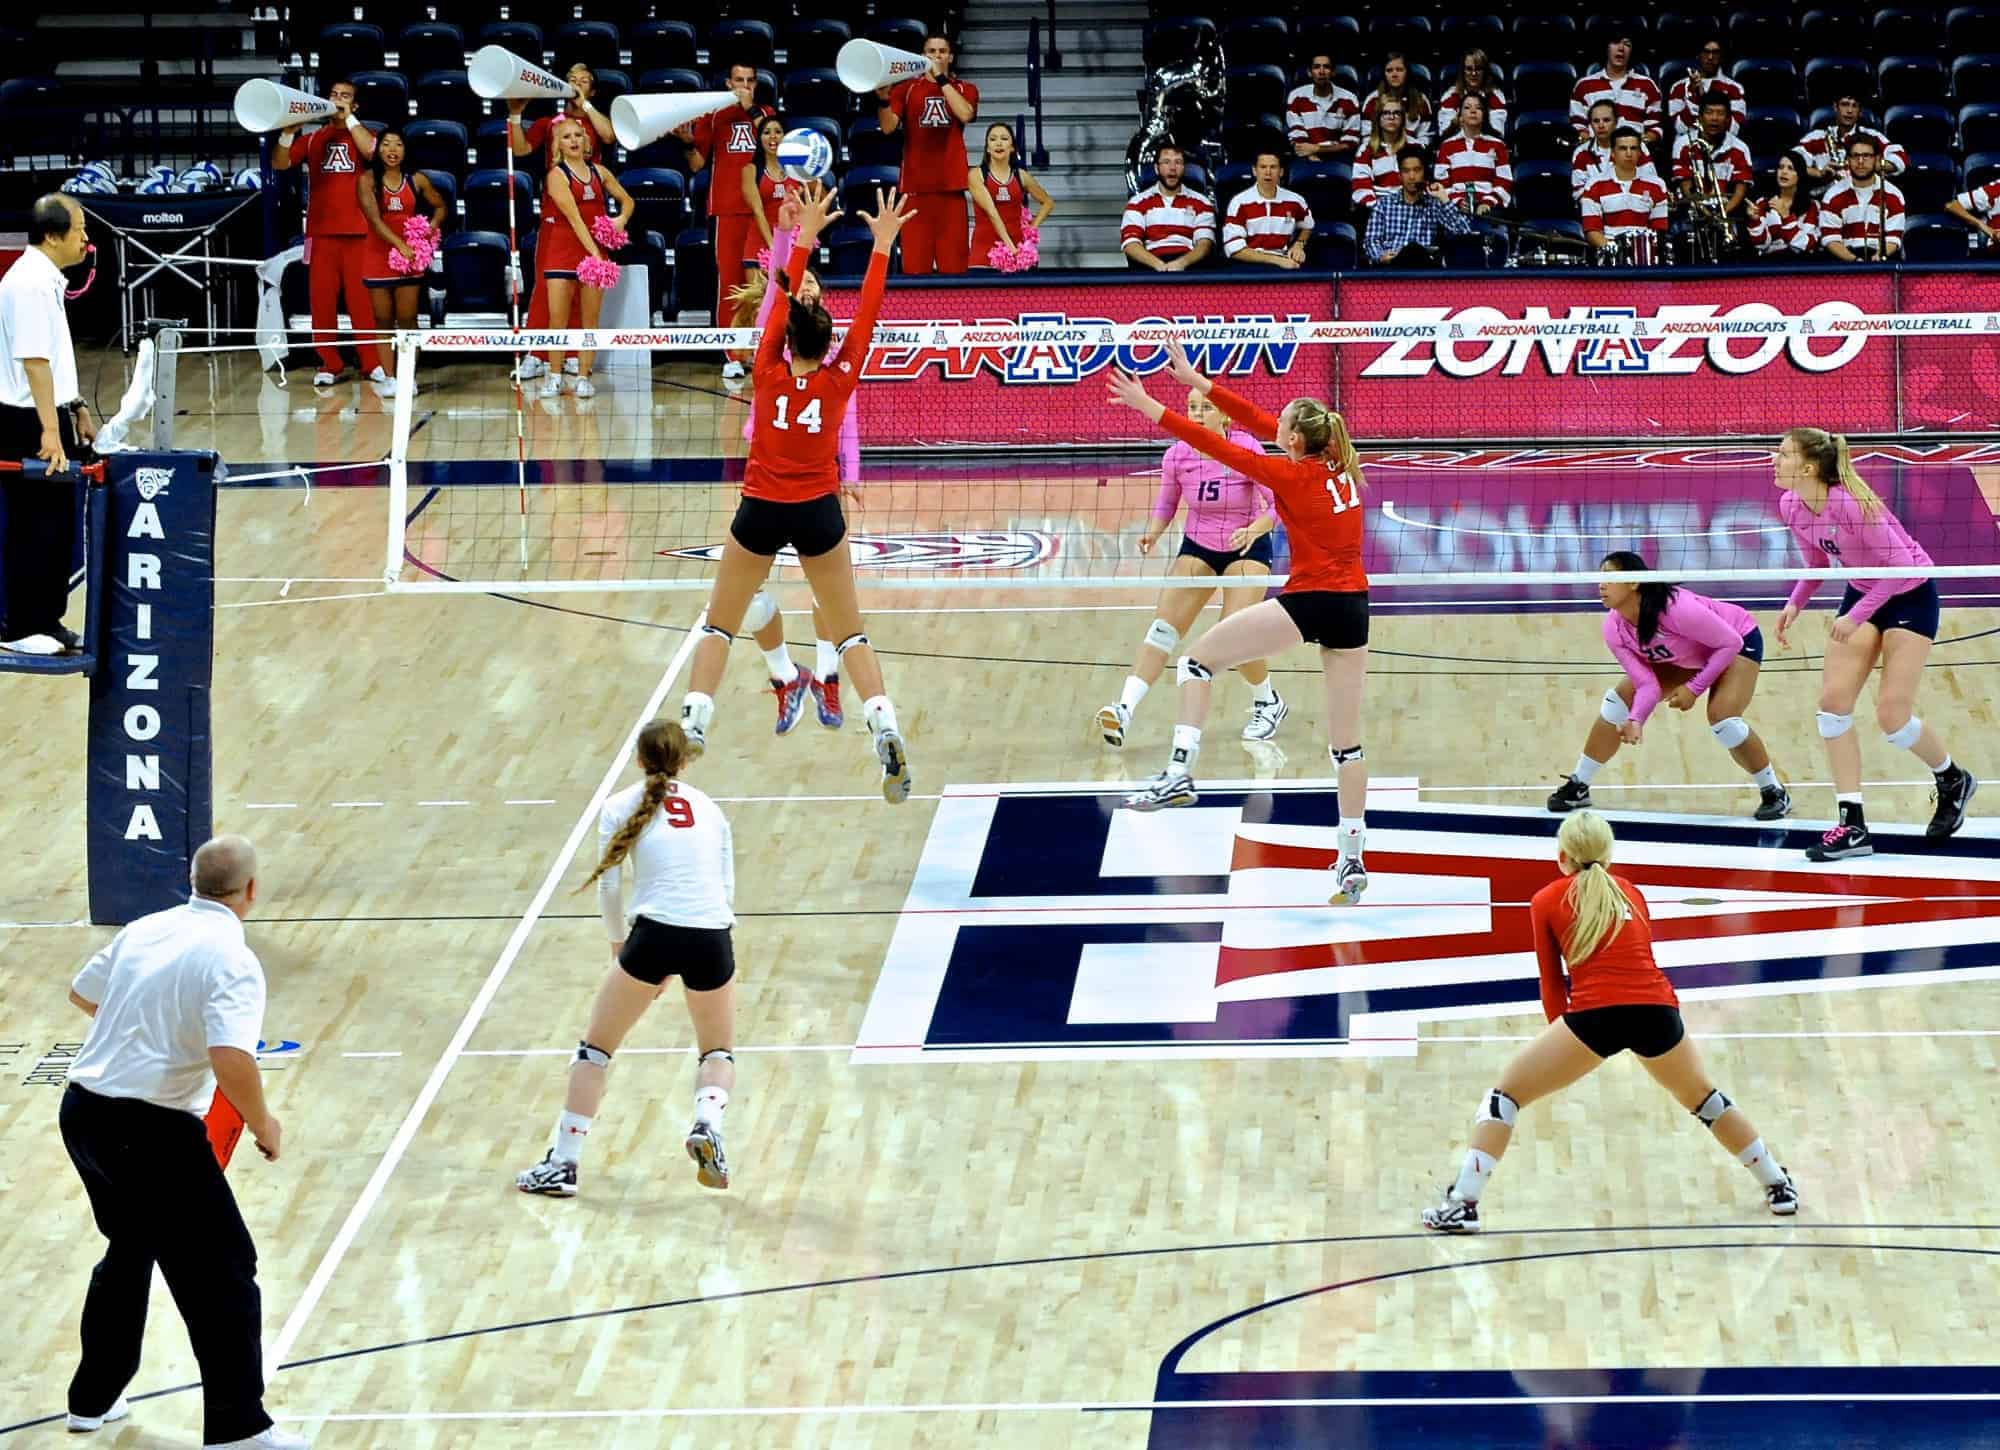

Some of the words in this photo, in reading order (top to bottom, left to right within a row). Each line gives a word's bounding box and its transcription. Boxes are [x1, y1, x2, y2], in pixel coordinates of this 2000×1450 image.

[321, 142, 355, 173] A
[143, 212, 184, 224] molten
[772, 394, 822, 433] 14
[1198, 480, 1221, 501] 15
[123, 501, 166, 841] ARIZONA
[663, 796, 695, 828] 9
